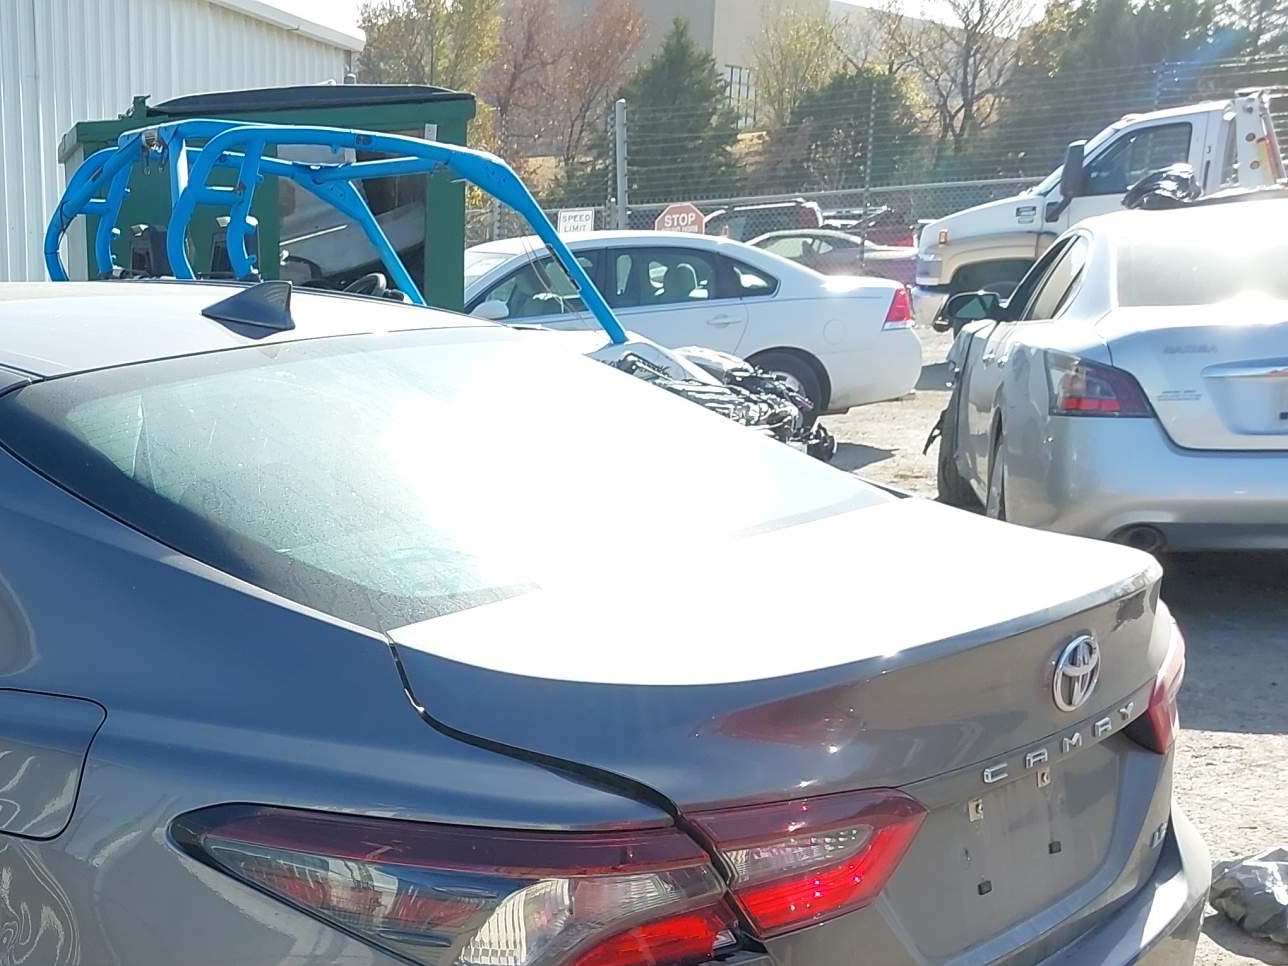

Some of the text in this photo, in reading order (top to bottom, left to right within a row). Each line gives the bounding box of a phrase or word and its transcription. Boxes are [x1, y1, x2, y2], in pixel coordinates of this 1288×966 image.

[562, 214, 591, 223] SPEED
[664, 212, 696, 227] STOP
[564, 224, 588, 232] LIMIT
[983, 701, 1135, 784] CAMRY
